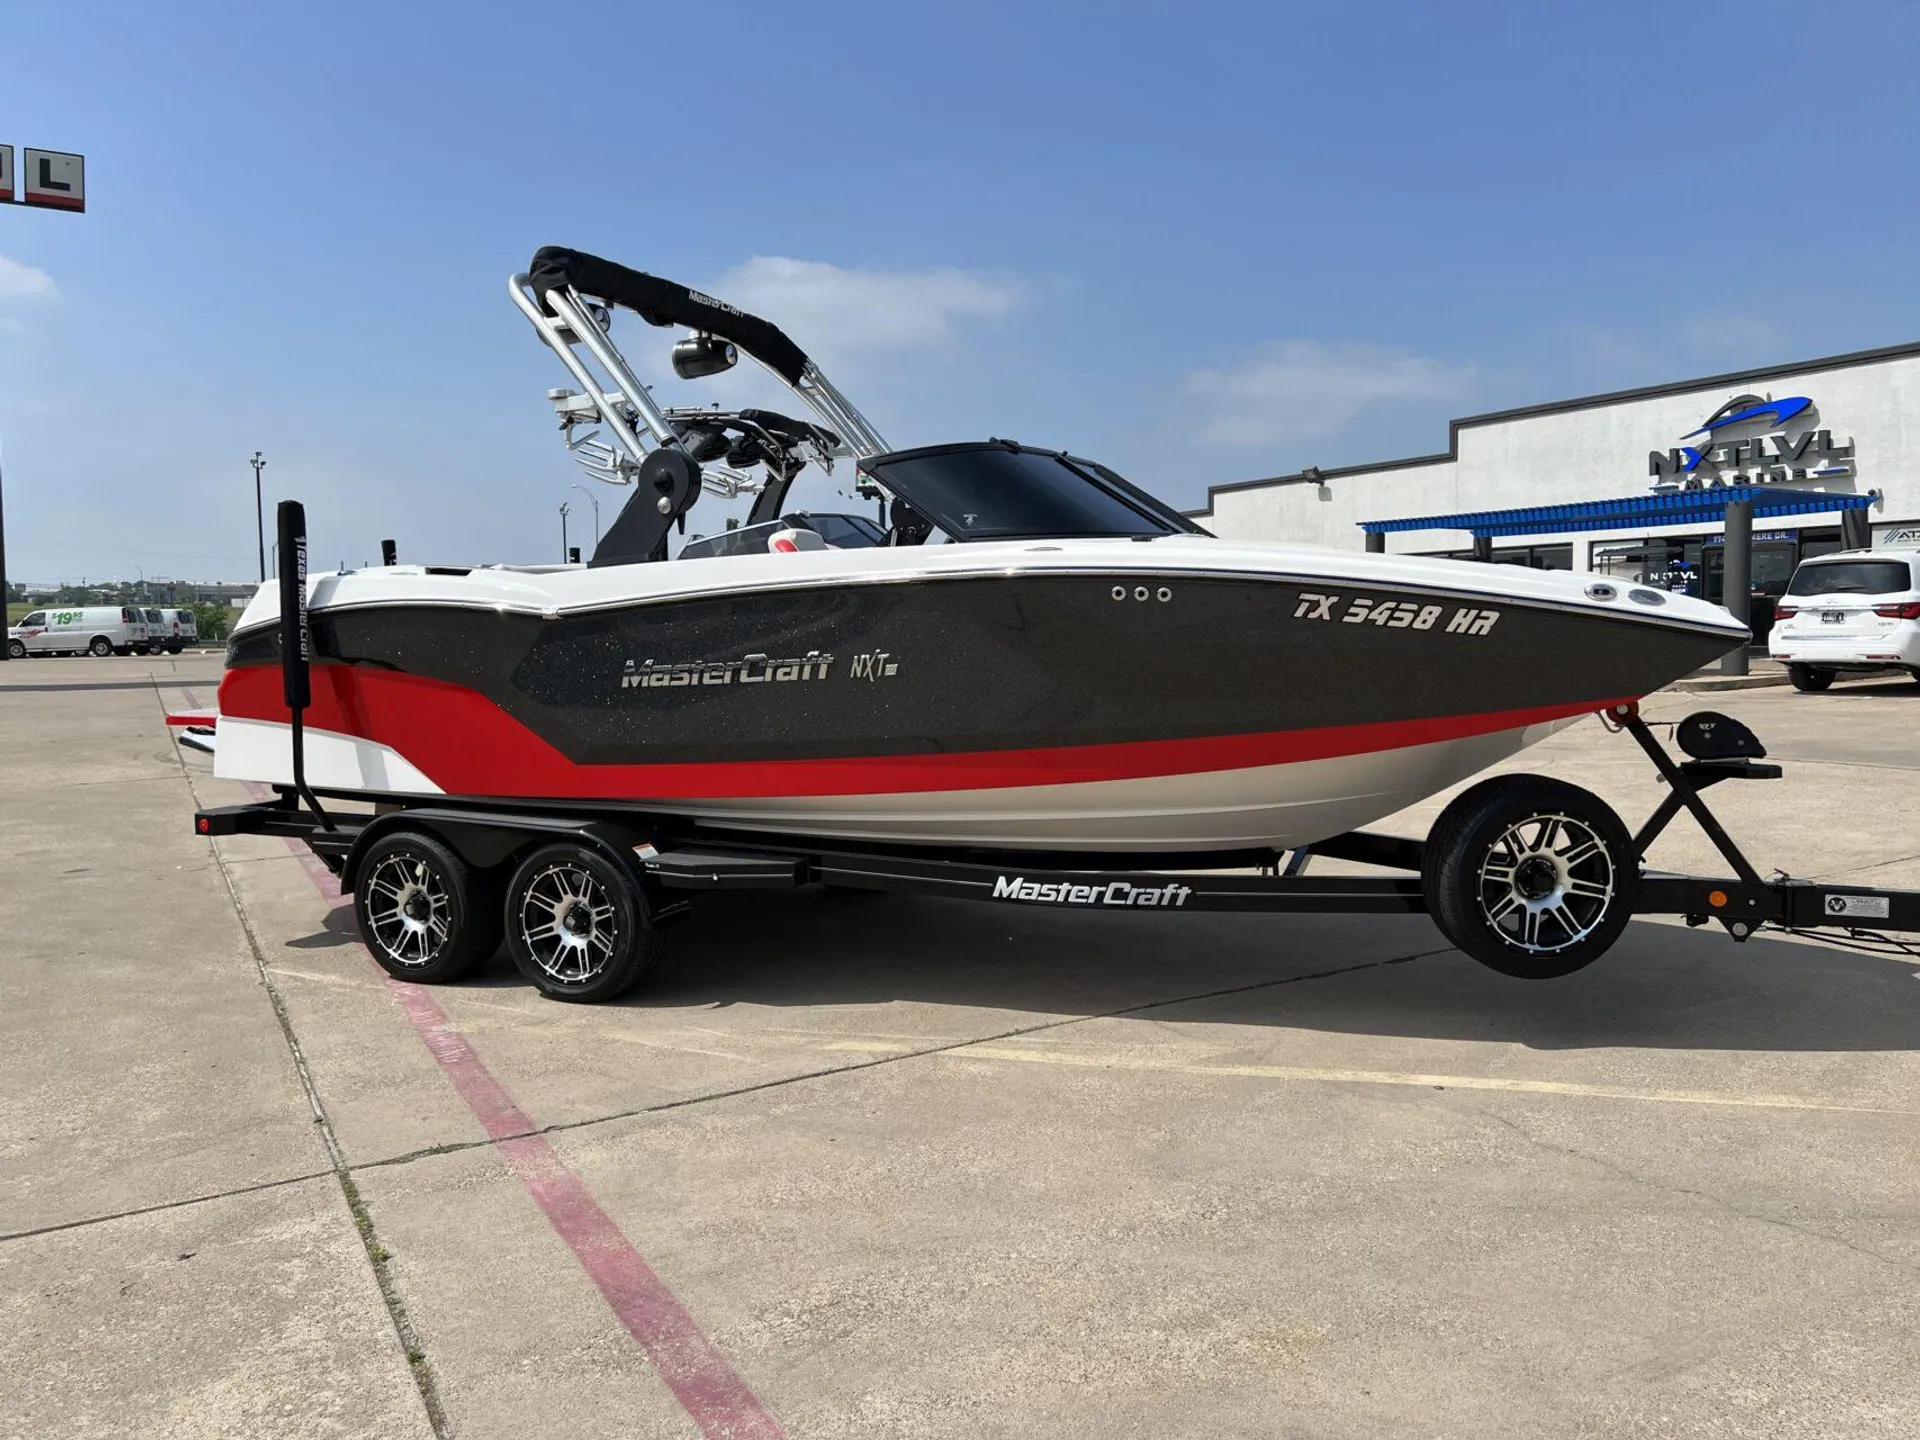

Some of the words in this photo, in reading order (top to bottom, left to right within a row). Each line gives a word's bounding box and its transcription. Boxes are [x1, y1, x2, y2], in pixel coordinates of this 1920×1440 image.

[1649, 429, 1856, 476] NXTLVL
[1684, 467, 1807, 490] MARINE
[296, 544, 307, 581] Texas
[1293, 593, 1340, 620] TX
[1445, 608, 1500, 636] HR
[621, 650, 834, 688] MasterCraft
[992, 875, 1192, 907] MasterCraft
